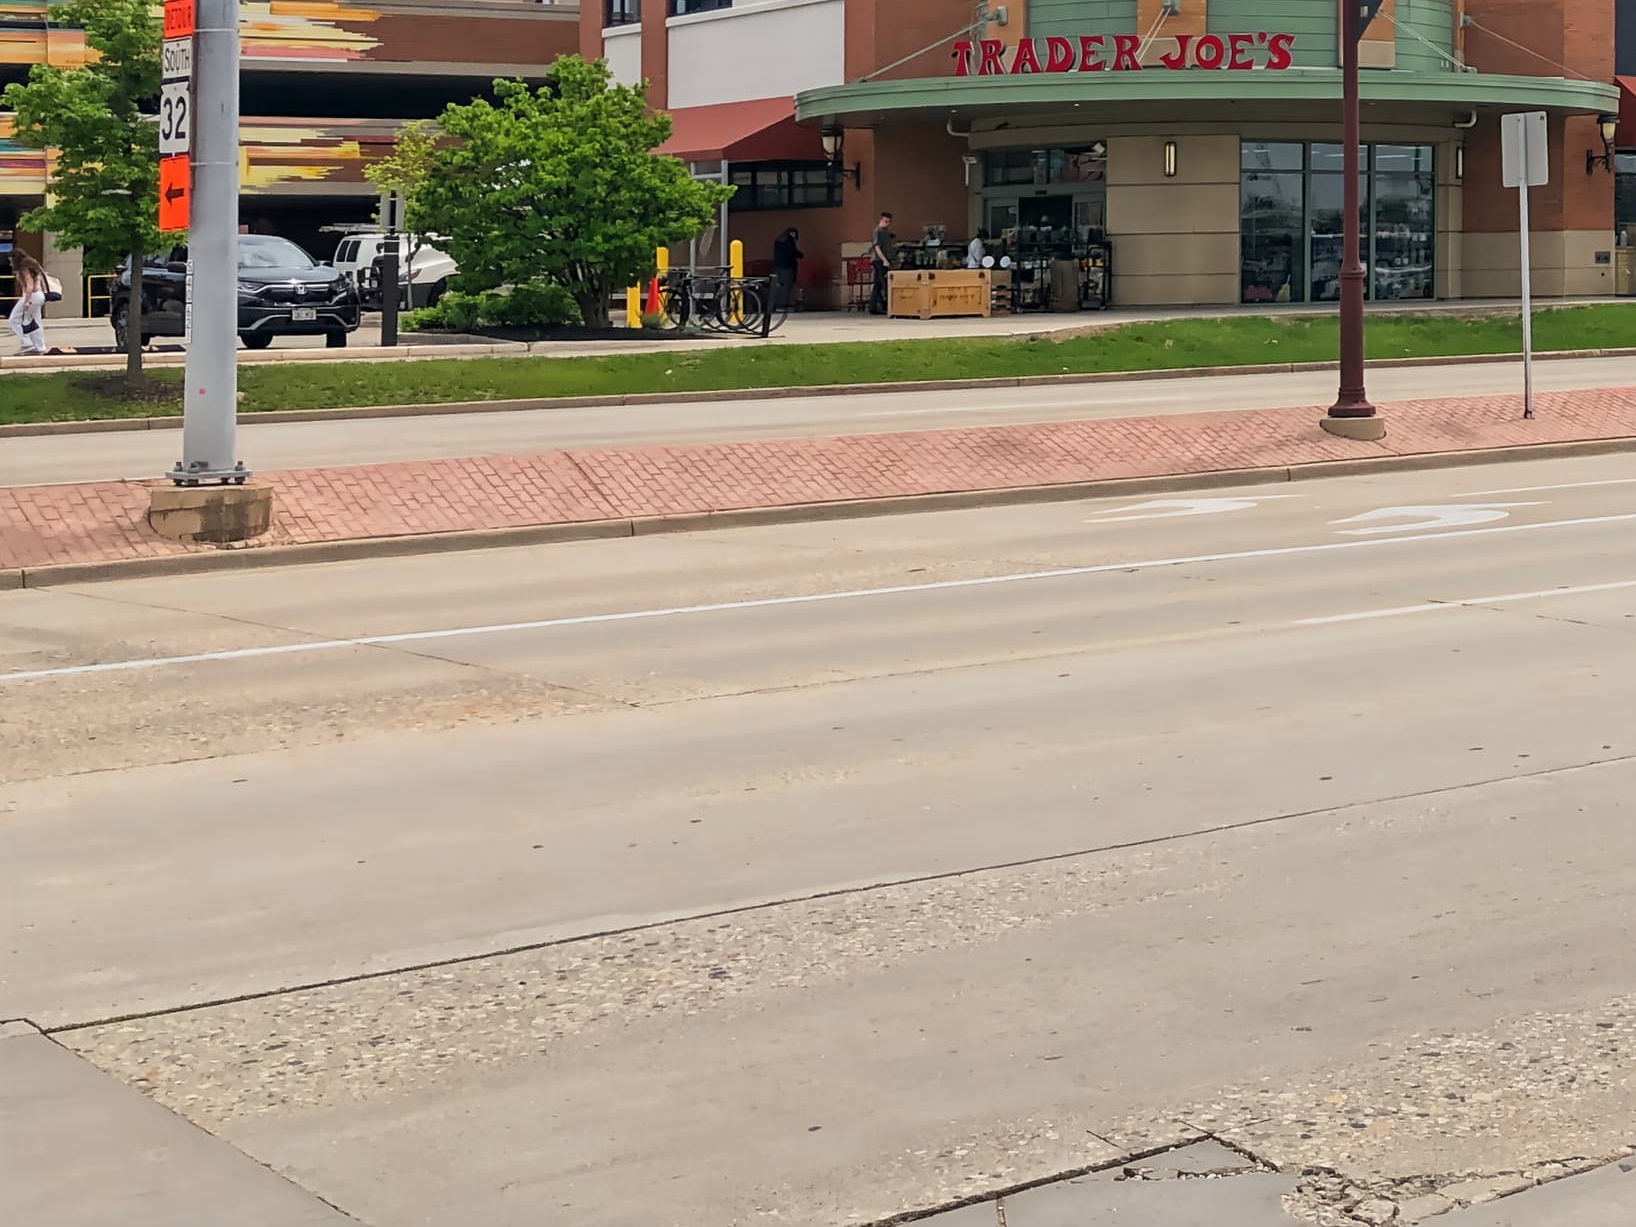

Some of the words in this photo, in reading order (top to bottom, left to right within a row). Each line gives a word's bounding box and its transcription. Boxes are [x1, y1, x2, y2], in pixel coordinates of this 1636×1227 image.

[164, 47, 190, 73] SOUTH
[952, 35, 1143, 76] TRADER
[1159, 32, 1296, 71] JOE'S
[161, 95, 187, 141] 32
